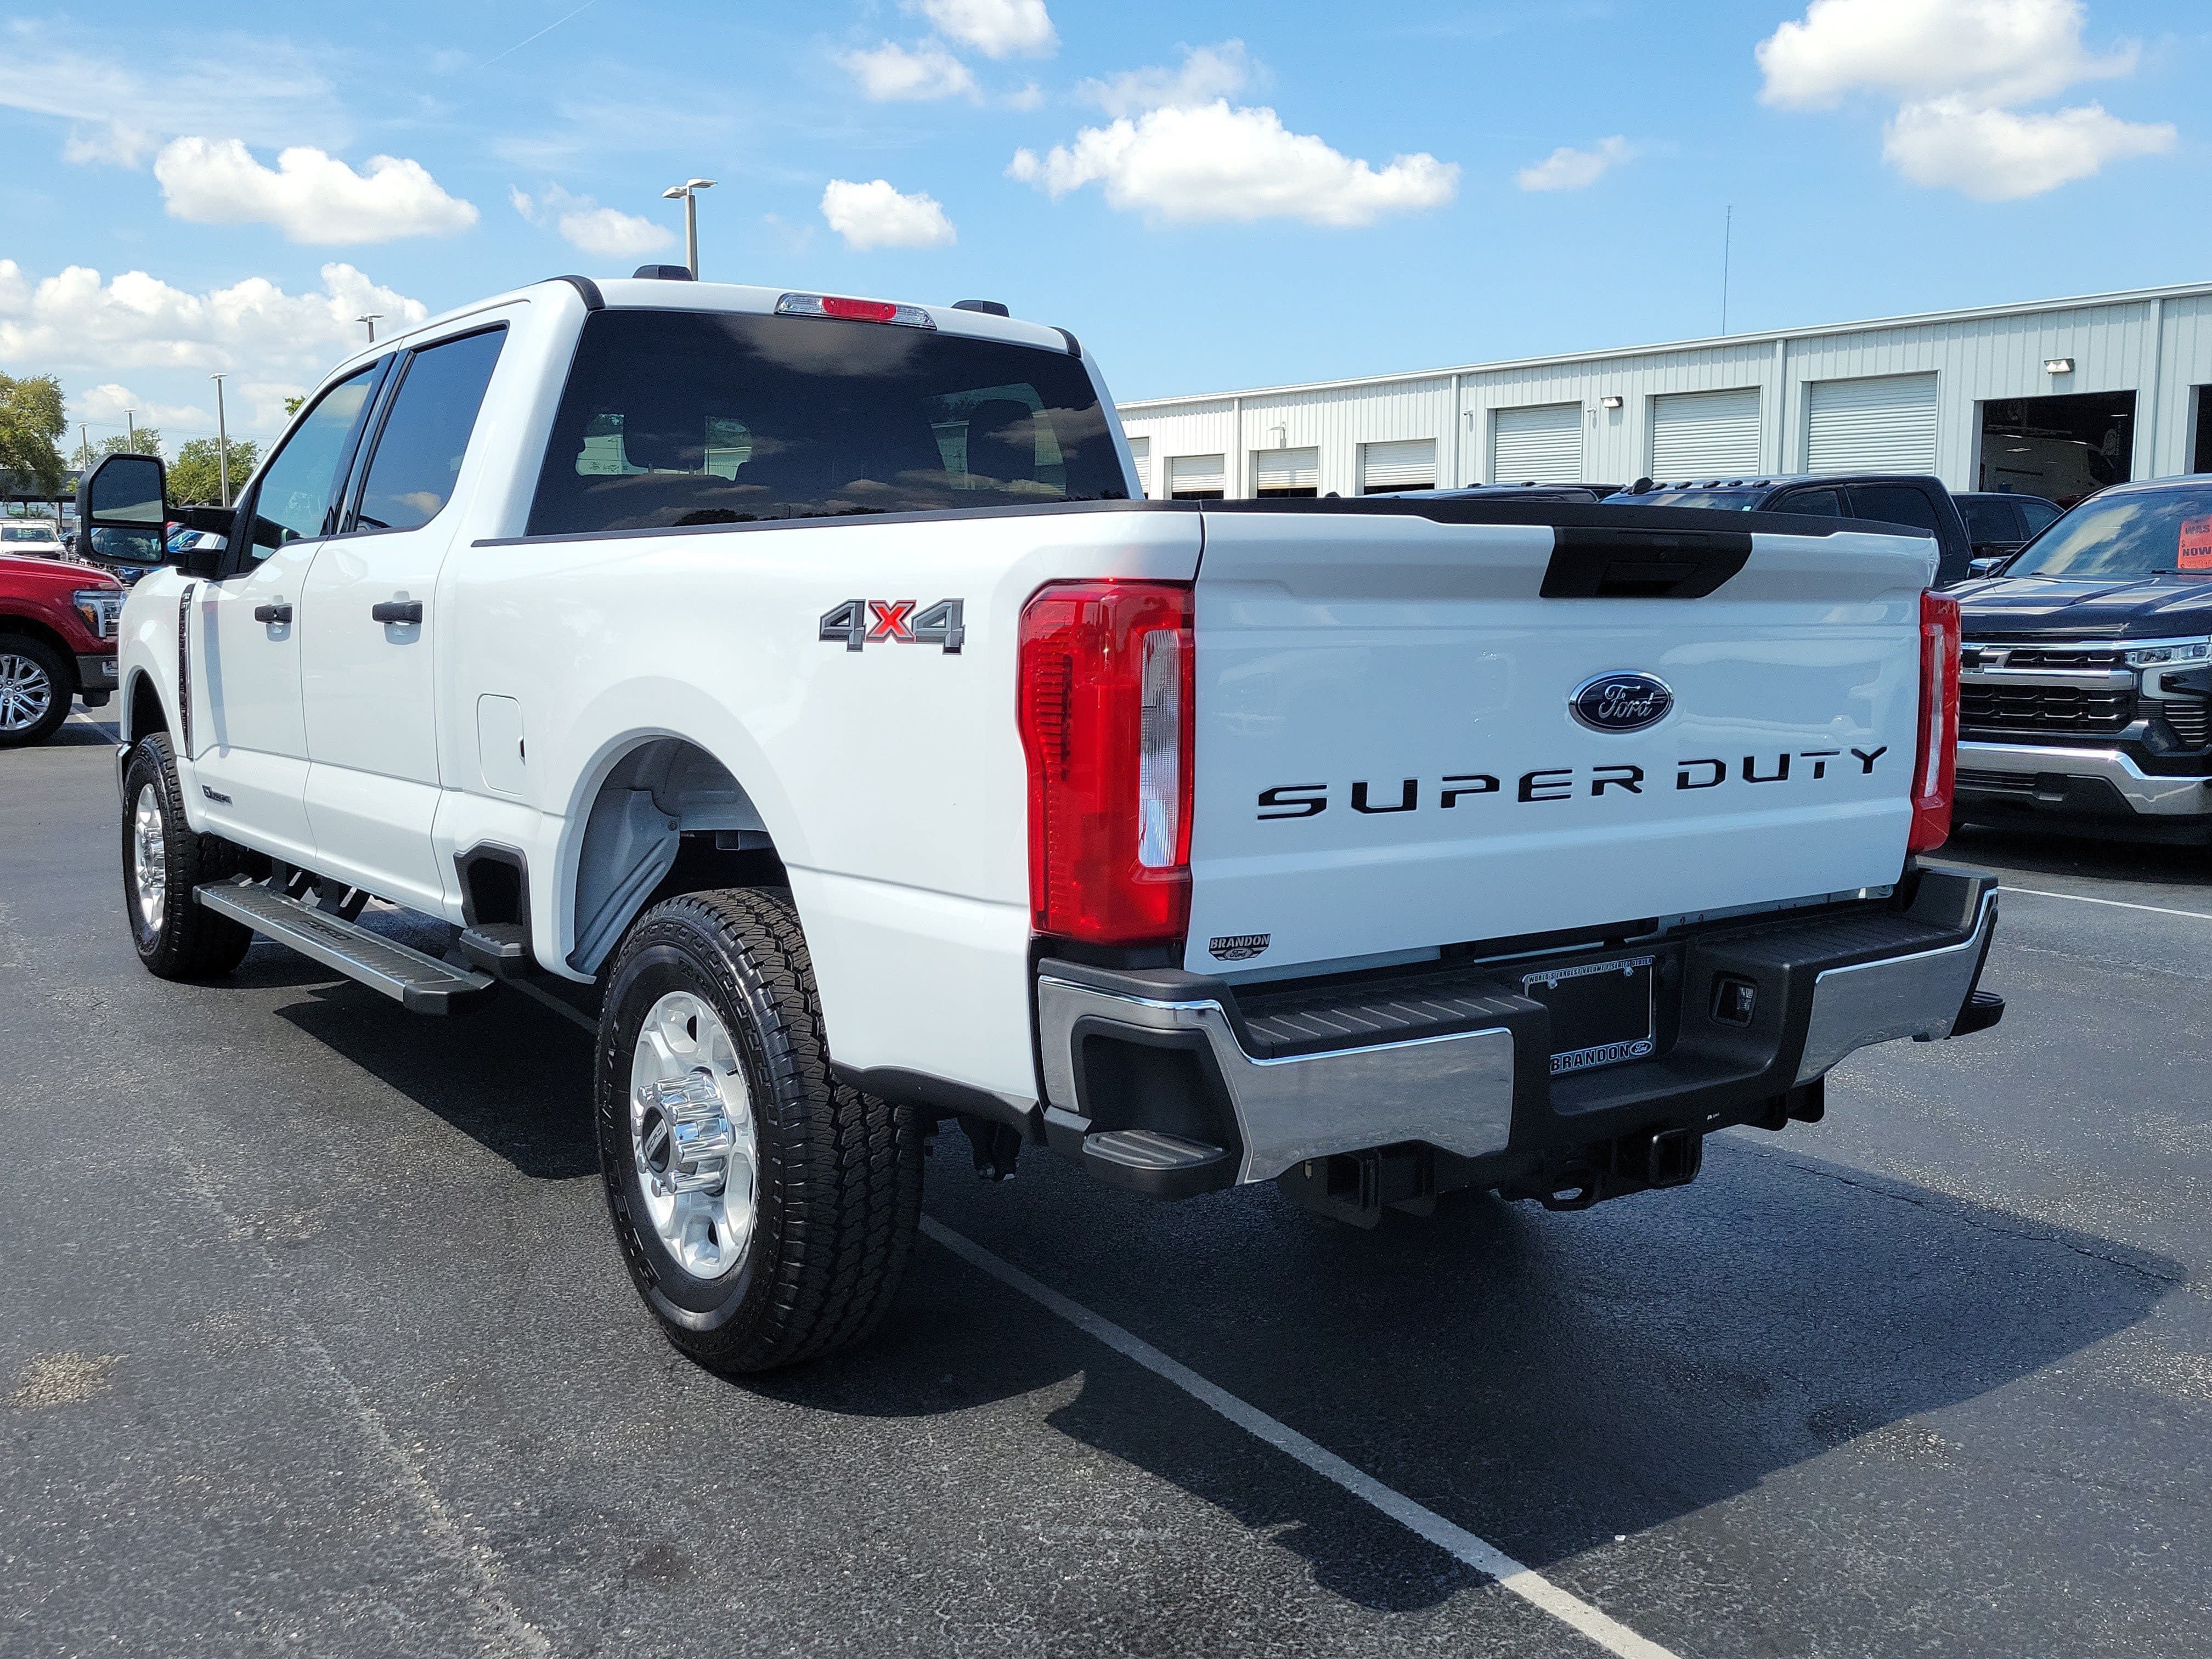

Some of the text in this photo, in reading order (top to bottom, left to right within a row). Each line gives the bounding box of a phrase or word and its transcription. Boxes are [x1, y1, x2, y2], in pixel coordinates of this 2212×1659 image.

[2185, 524, 2210, 534] WAS
[2183, 546, 2211, 557] NOW
[1598, 684, 1654, 719] Ford
[1257, 746, 1888, 821] SUPER DUTY
[1210, 934, 1271, 949] BRANDON
[1229, 949, 1247, 958] Ford
[1551, 1043, 1649, 1072] BRANDON Ford
